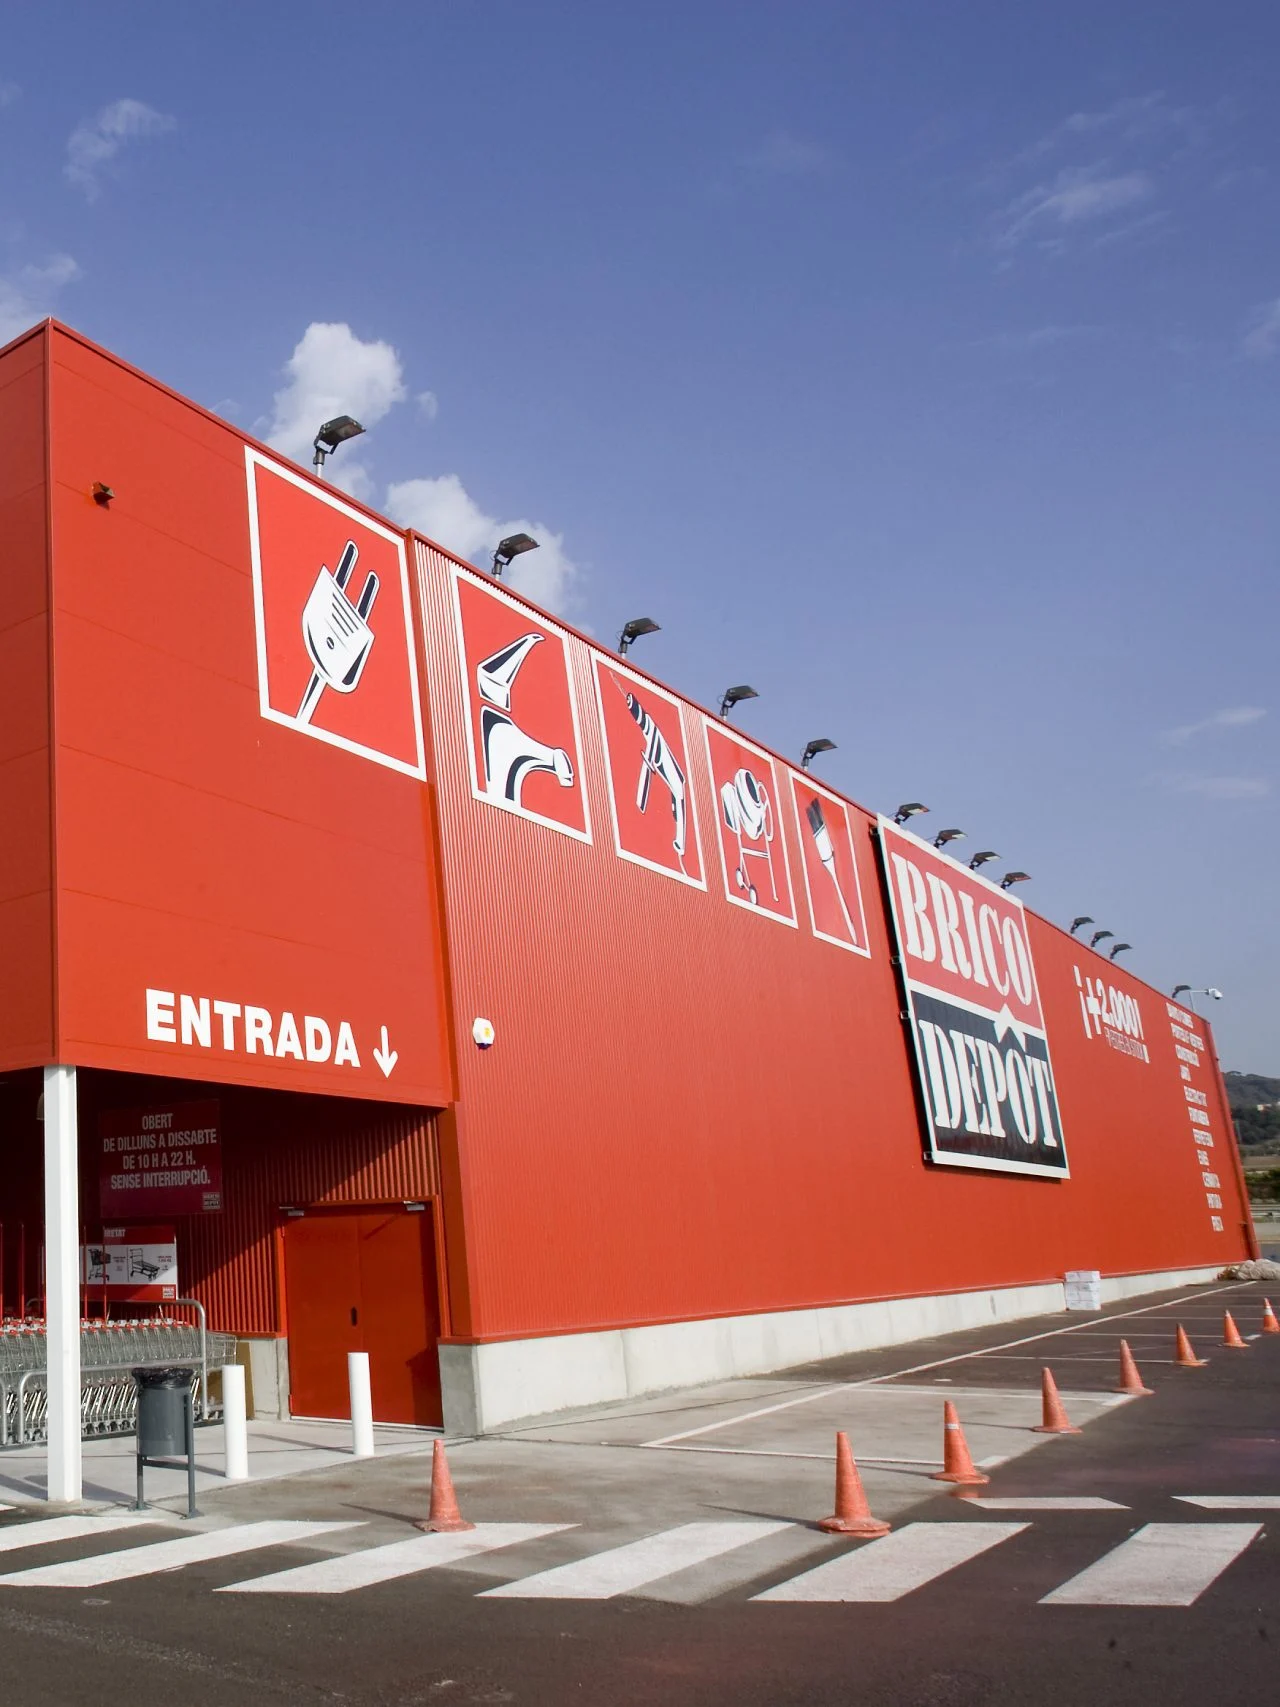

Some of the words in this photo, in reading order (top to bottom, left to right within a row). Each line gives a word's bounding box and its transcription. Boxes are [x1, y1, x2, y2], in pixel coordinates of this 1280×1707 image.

[891, 851, 1032, 1006] BRICO
[146, 988, 361, 1068] ENTRADA
[142, 1113, 173, 1130] OBERT
[103, 1138, 115, 1152] DE
[117, 1134, 156, 1151] DILLUNS
[158, 1133, 166, 1148] A
[168, 1129, 217, 1147] DISSABTE
[122, 1155, 135, 1170] DE
[137, 1154, 149, 1168] 10
[152, 1153, 158, 1167] H
[161, 1152, 169, 1167] A
[171, 1151, 183, 1166] 22
[185, 1150, 196, 1166] H.
[111, 1174, 140, 1190] SENSE
[143, 1165, 211, 1188] INTERRUPCIÓ.
